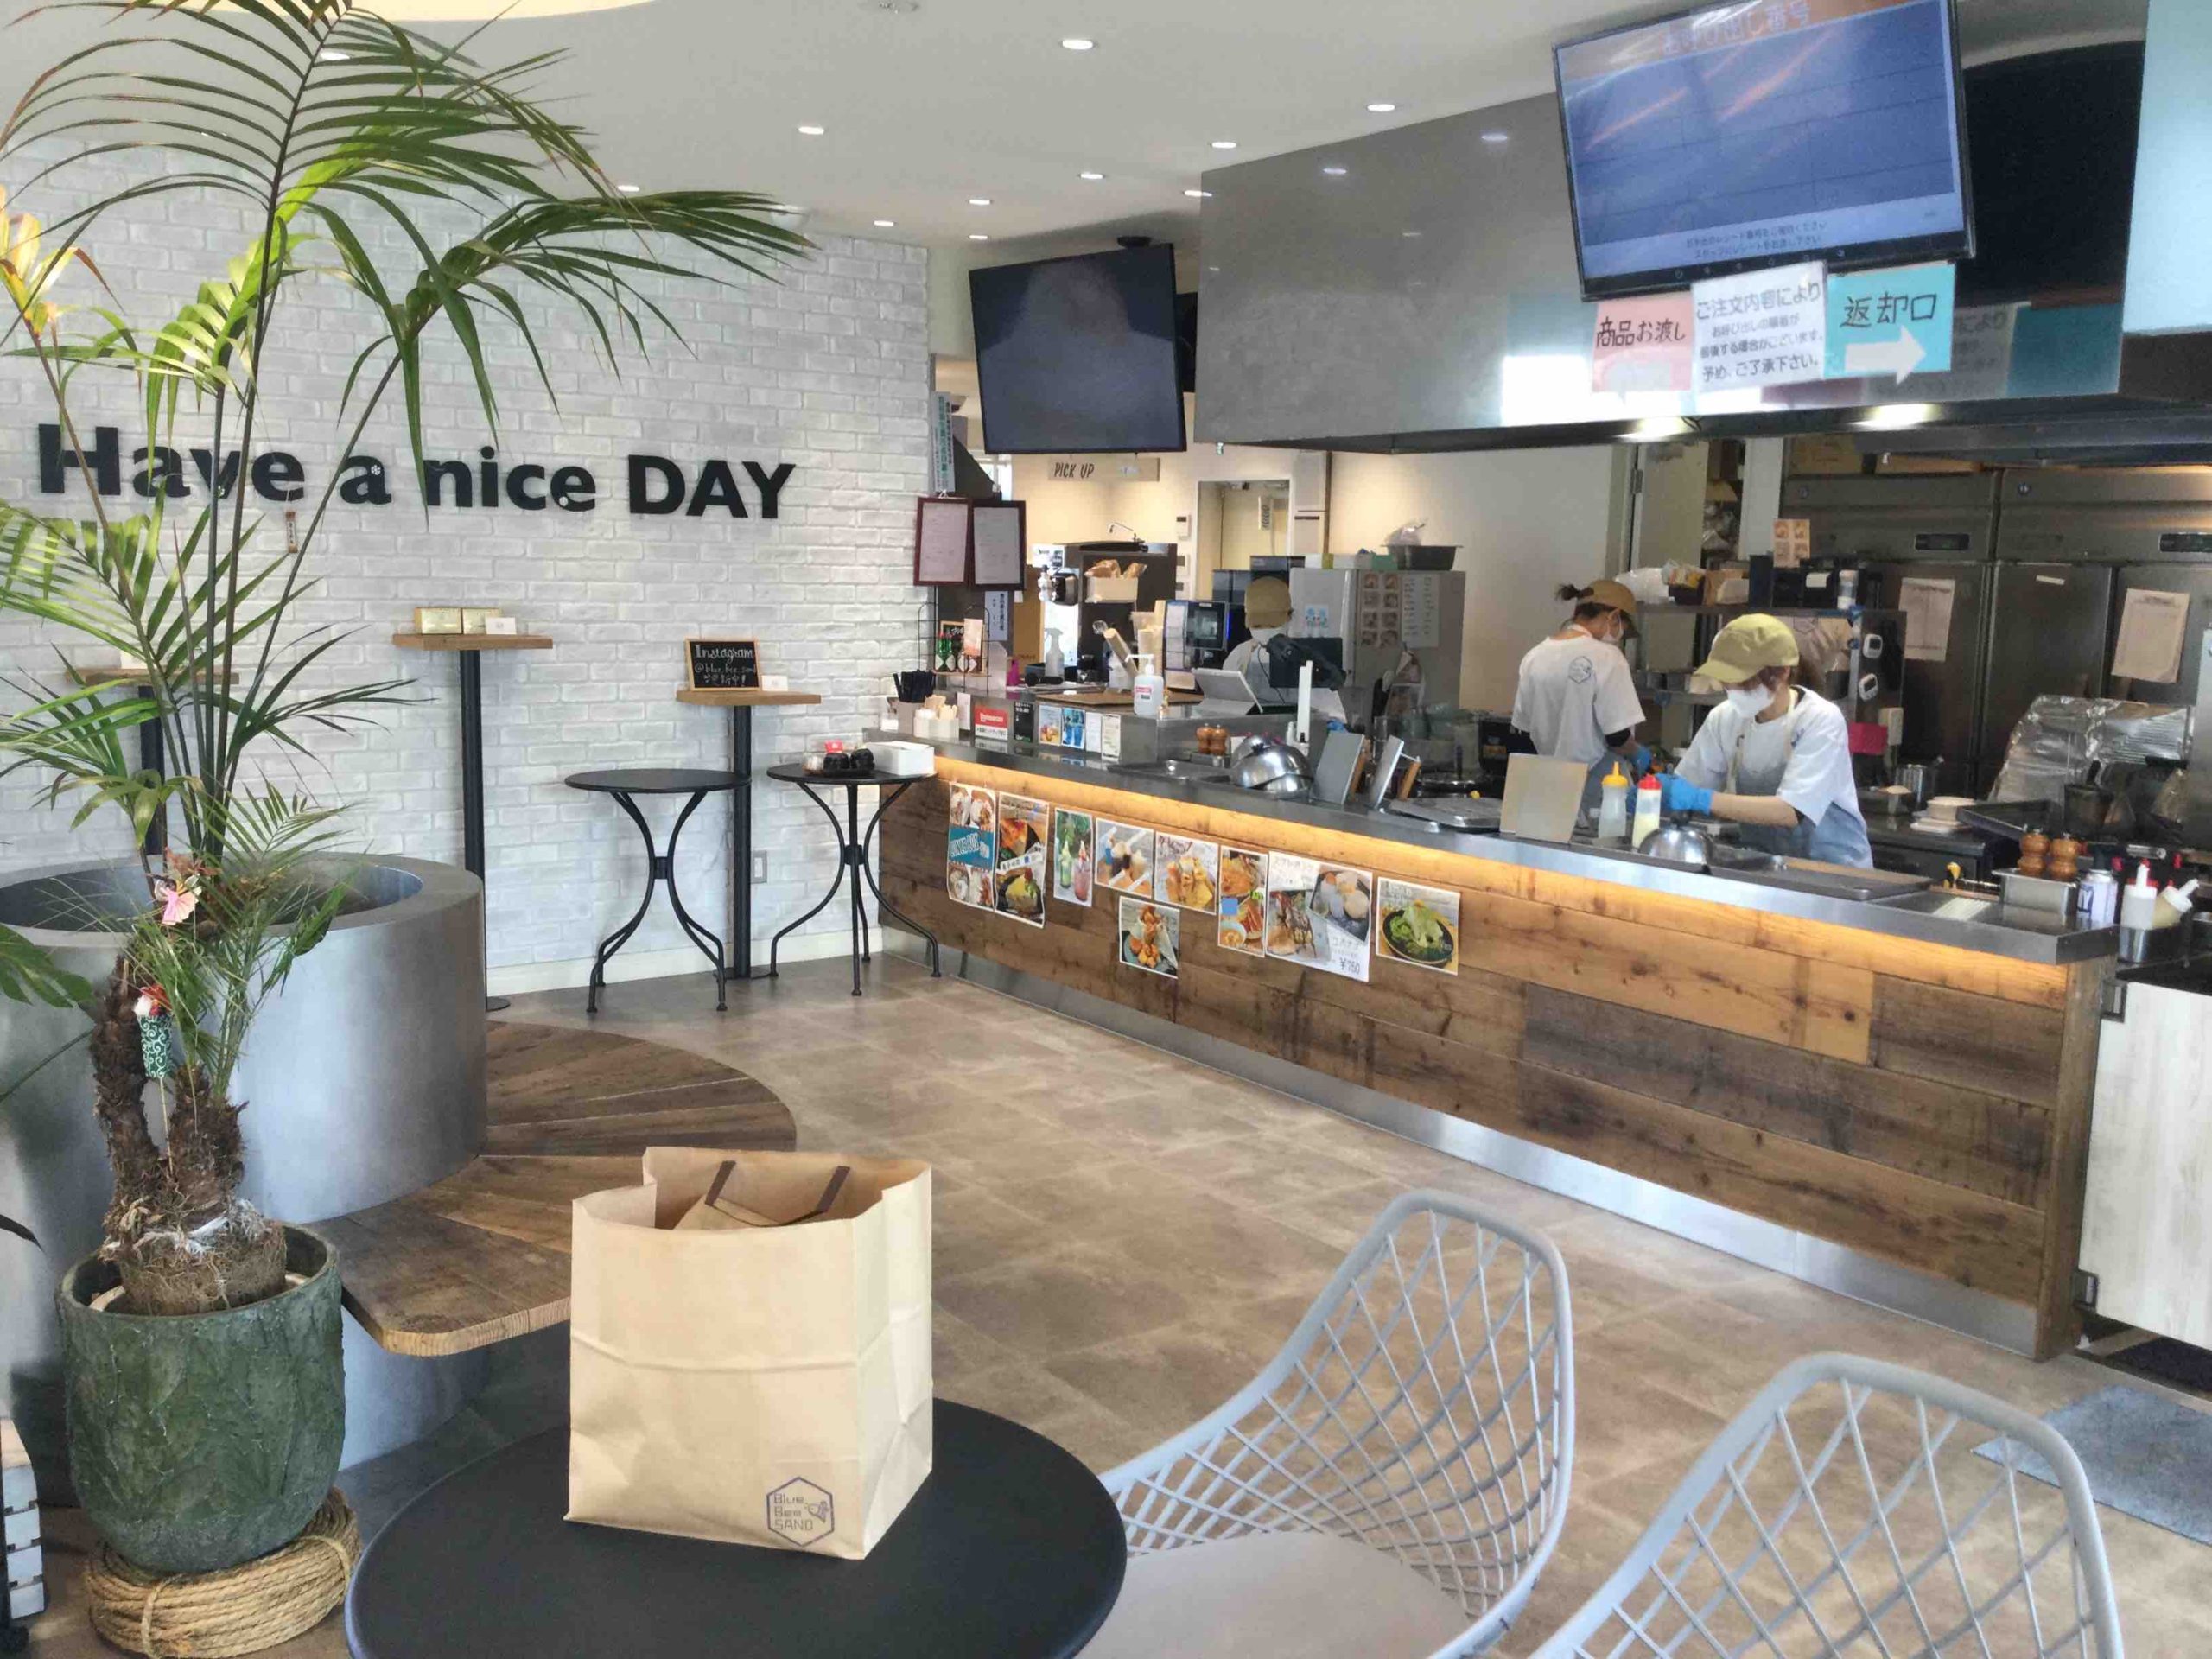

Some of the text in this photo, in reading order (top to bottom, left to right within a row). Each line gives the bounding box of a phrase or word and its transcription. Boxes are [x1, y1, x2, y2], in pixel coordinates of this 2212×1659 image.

[1696, 282, 1821, 320] ご注文内容により
[1840, 292, 1938, 328] 返却口
[1595, 316, 1686, 348] 商品お渡し
[37, 423, 797, 520] Have a nice DAY
[1054, 461, 1095, 480] PICK UP
[695, 644, 754, 664] Instagram
[773, 1493, 804, 1504] Blue
[774, 1505, 802, 1518] Bee
[774, 1518, 814, 1531] SAND
